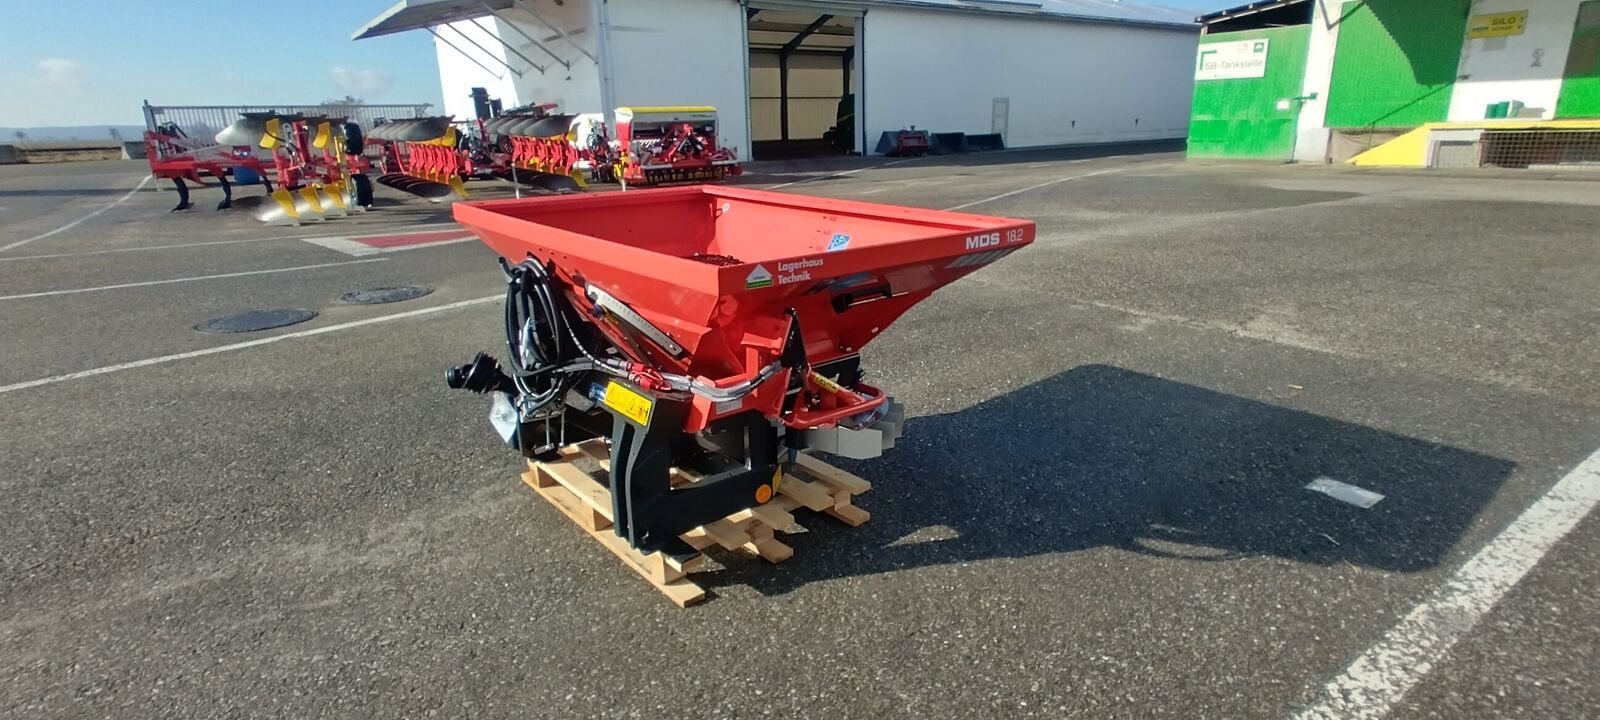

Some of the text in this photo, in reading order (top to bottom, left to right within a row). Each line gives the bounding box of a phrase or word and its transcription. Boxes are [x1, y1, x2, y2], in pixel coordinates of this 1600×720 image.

[1491, 16, 1516, 26] SILO
[1205, 60, 1264, 70] SB-Tankstelle
[966, 232, 1000, 250] MDS
[777, 258, 824, 273] Lagerhaus
[777, 271, 812, 285] Technik
